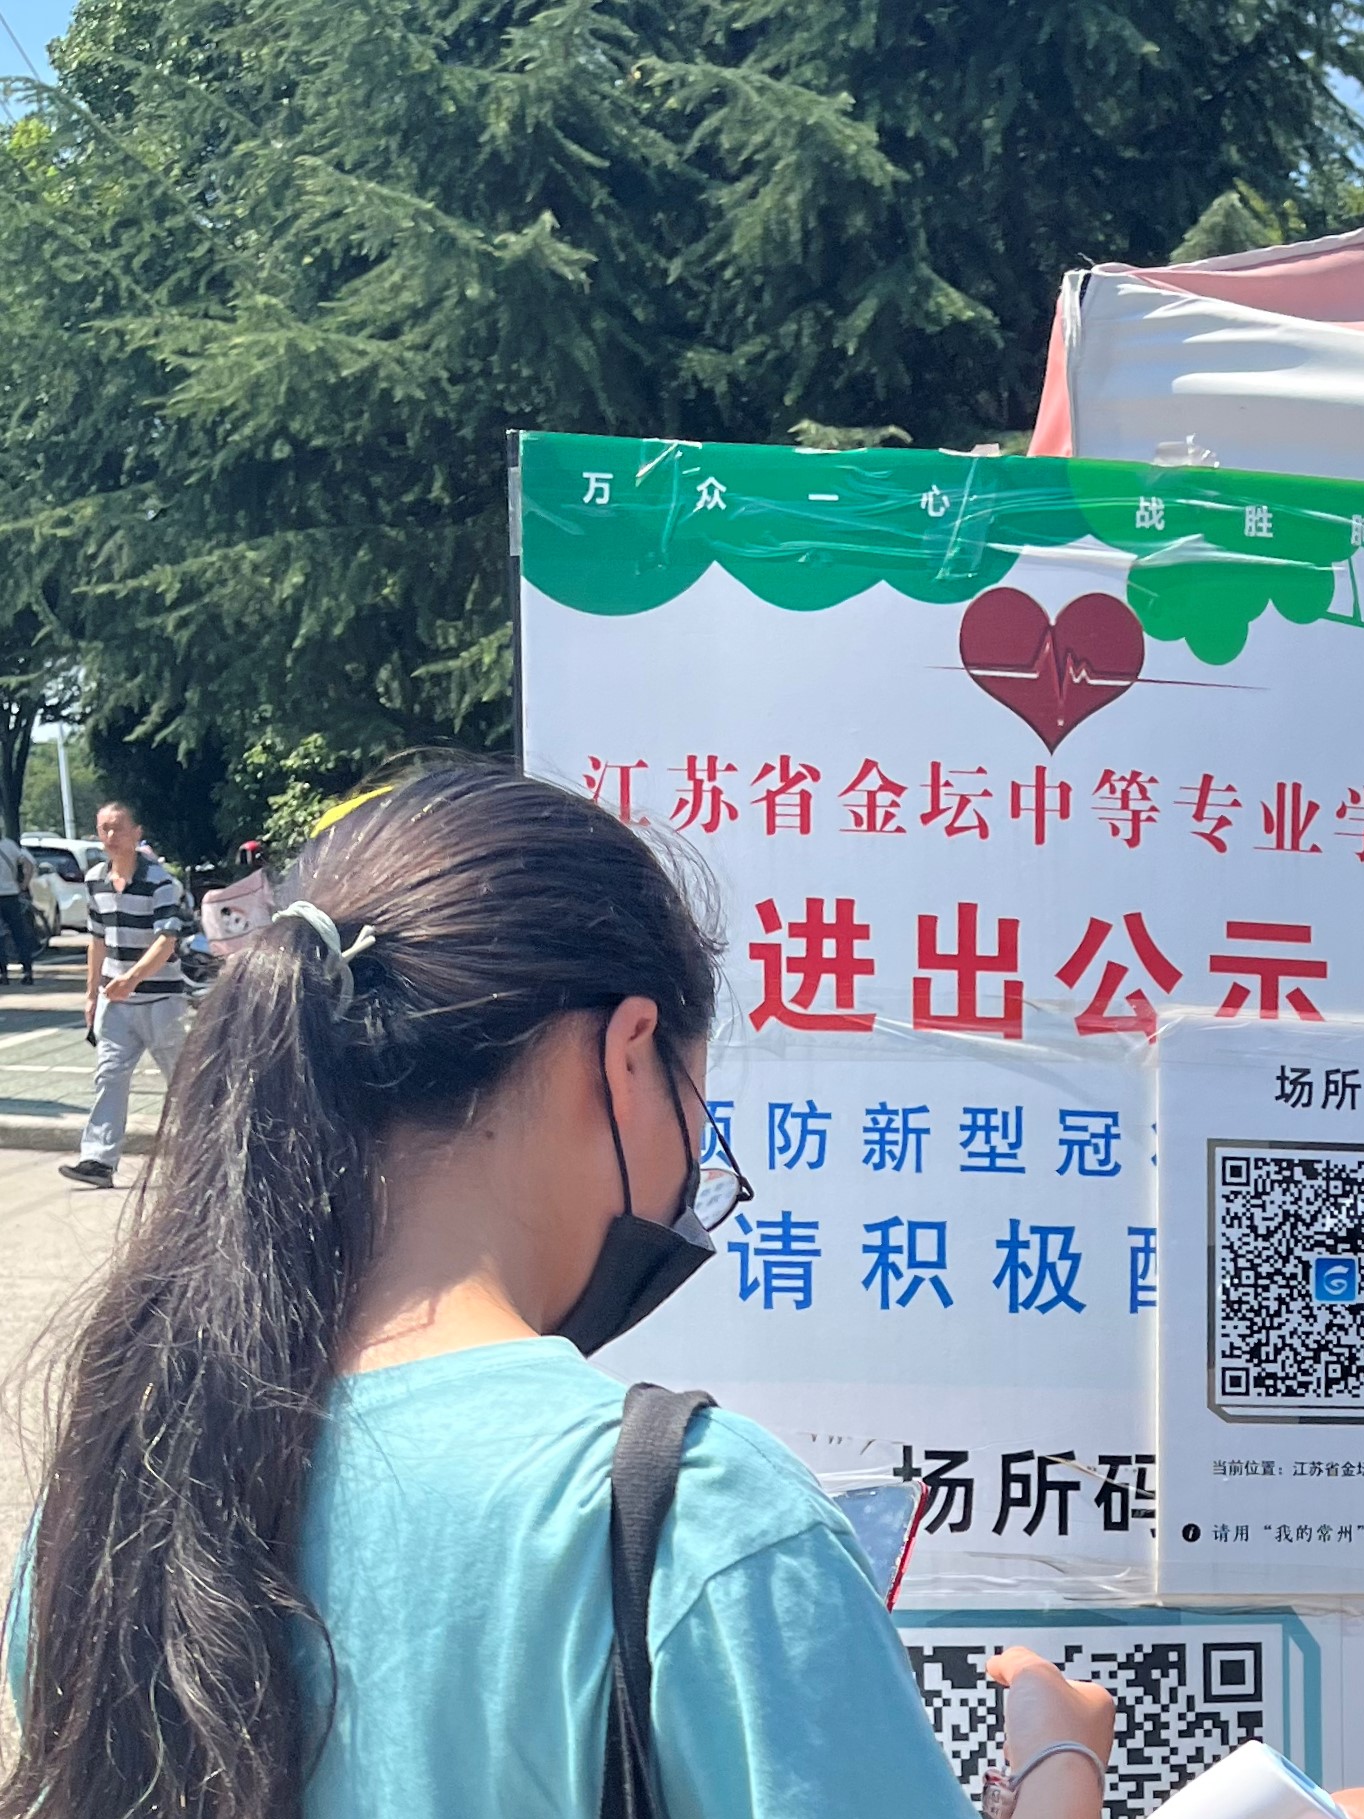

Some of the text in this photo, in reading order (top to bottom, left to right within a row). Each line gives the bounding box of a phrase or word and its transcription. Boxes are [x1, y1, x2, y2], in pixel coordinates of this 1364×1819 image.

[582, 472, 951, 518] 万众一心
[748, 896, 1328, 1044] 进出公示
[892, 1445, 1156, 1538] 场所码
